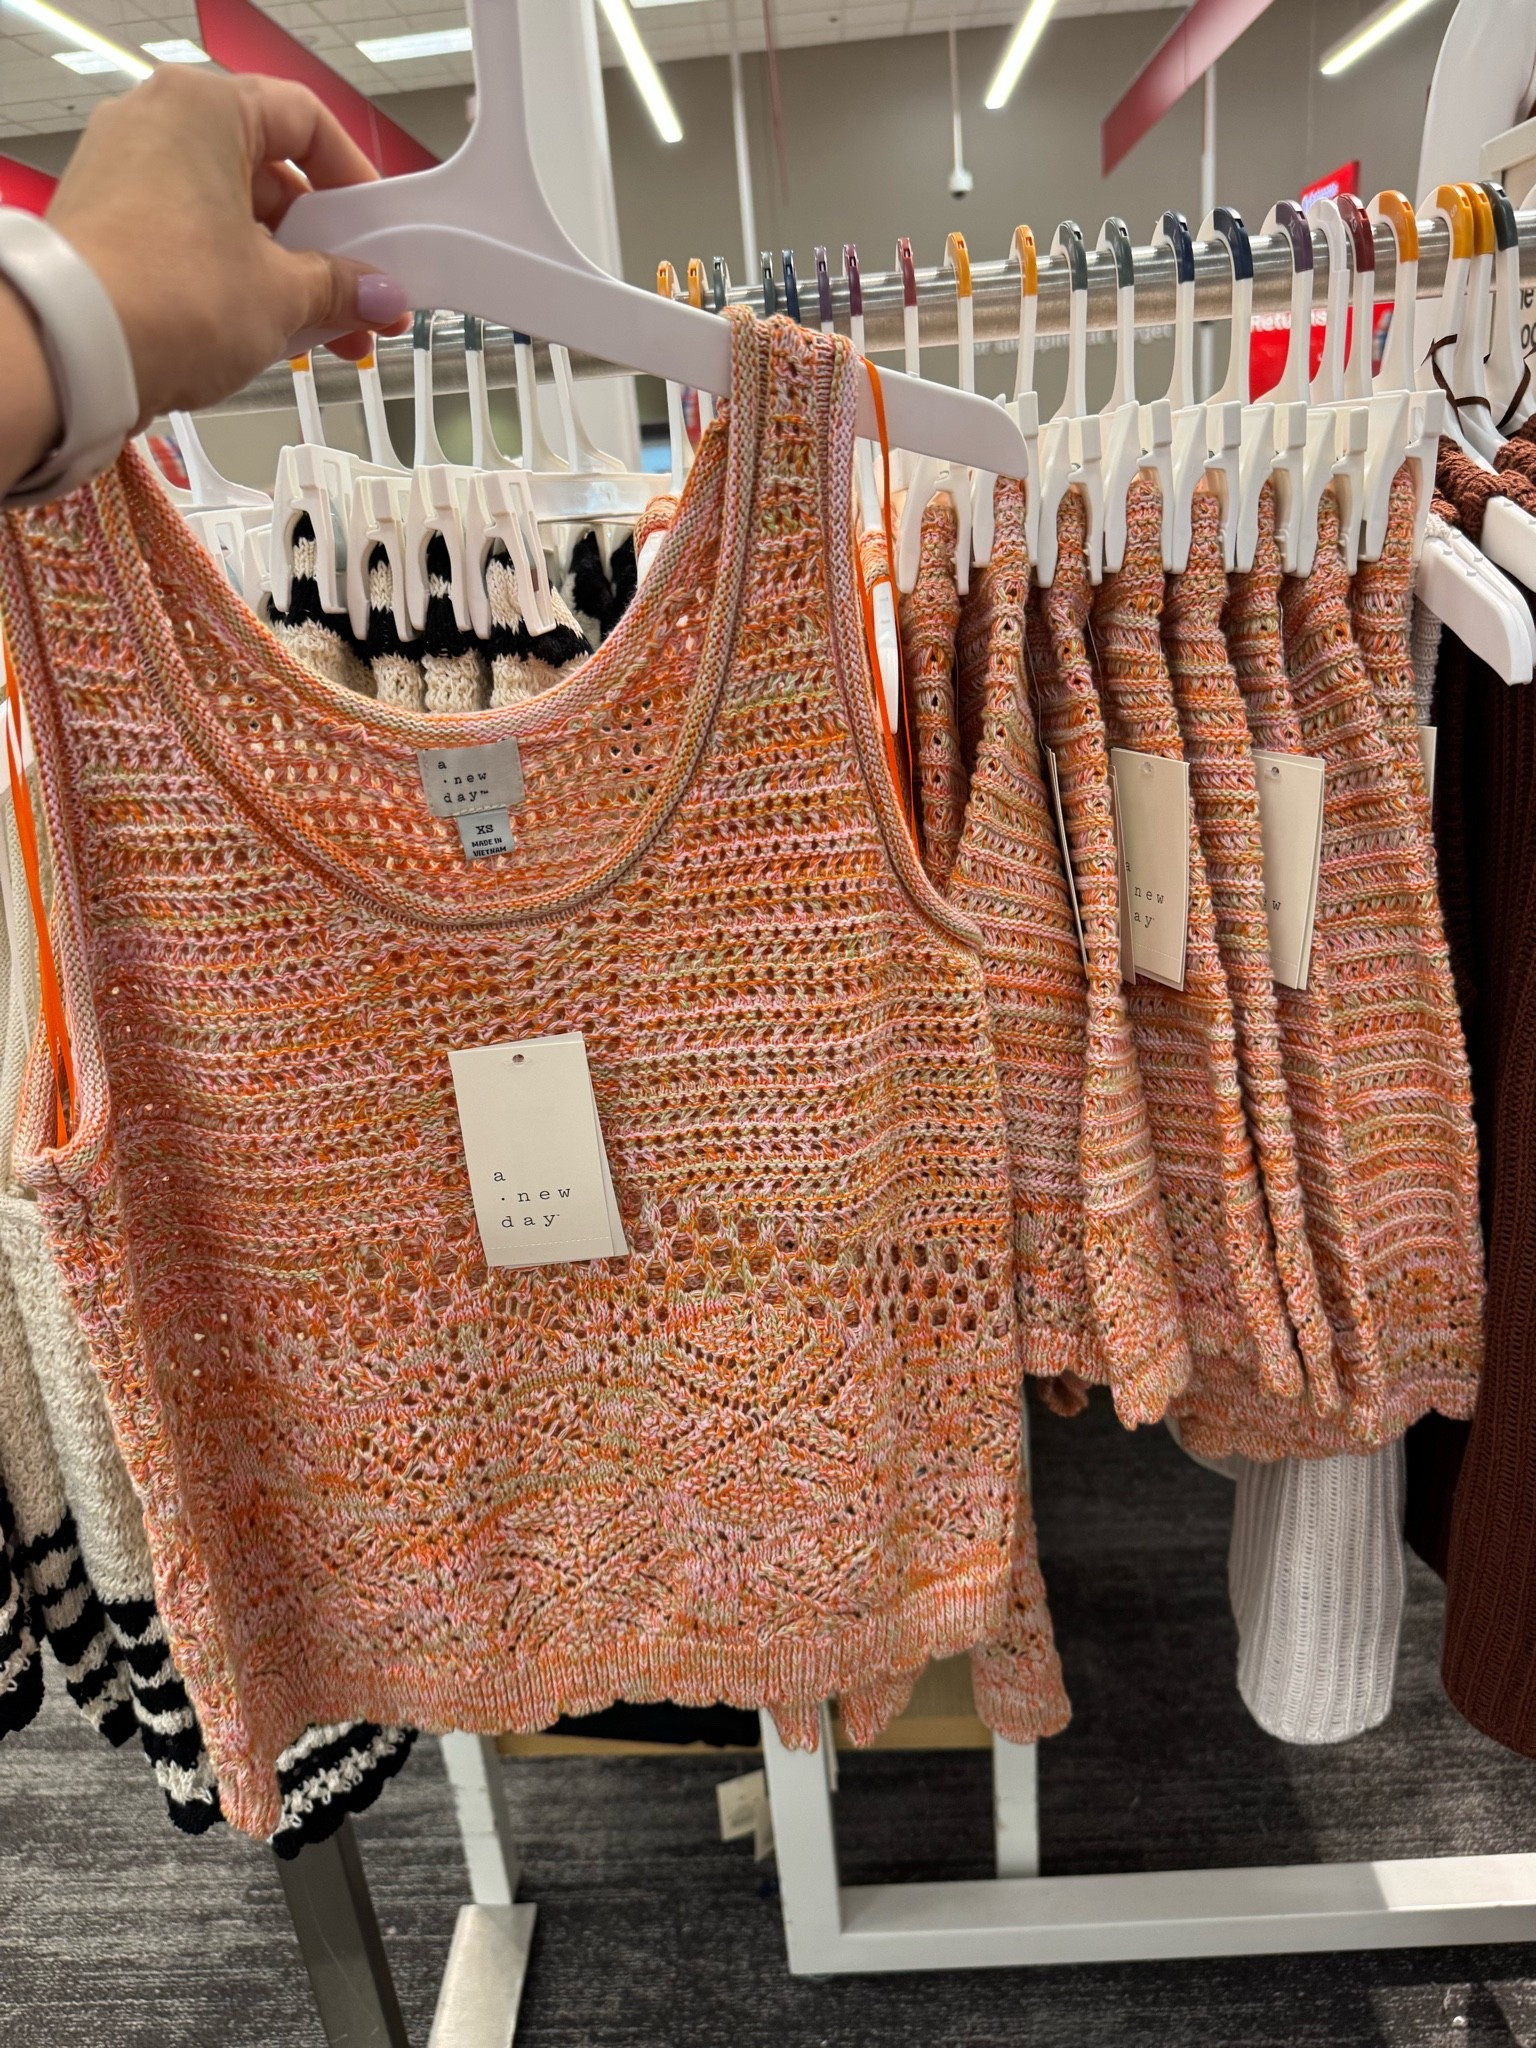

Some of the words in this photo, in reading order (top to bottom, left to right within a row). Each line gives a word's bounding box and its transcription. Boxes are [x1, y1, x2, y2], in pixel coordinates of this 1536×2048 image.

[437, 760, 447, 770] a
[475, 824, 494, 835] XS
[471, 838, 493, 848] MADE
[494, 837, 503, 845] IN
[472, 845, 507, 857] VIETNAM
[493, 1171, 506, 1182] a
